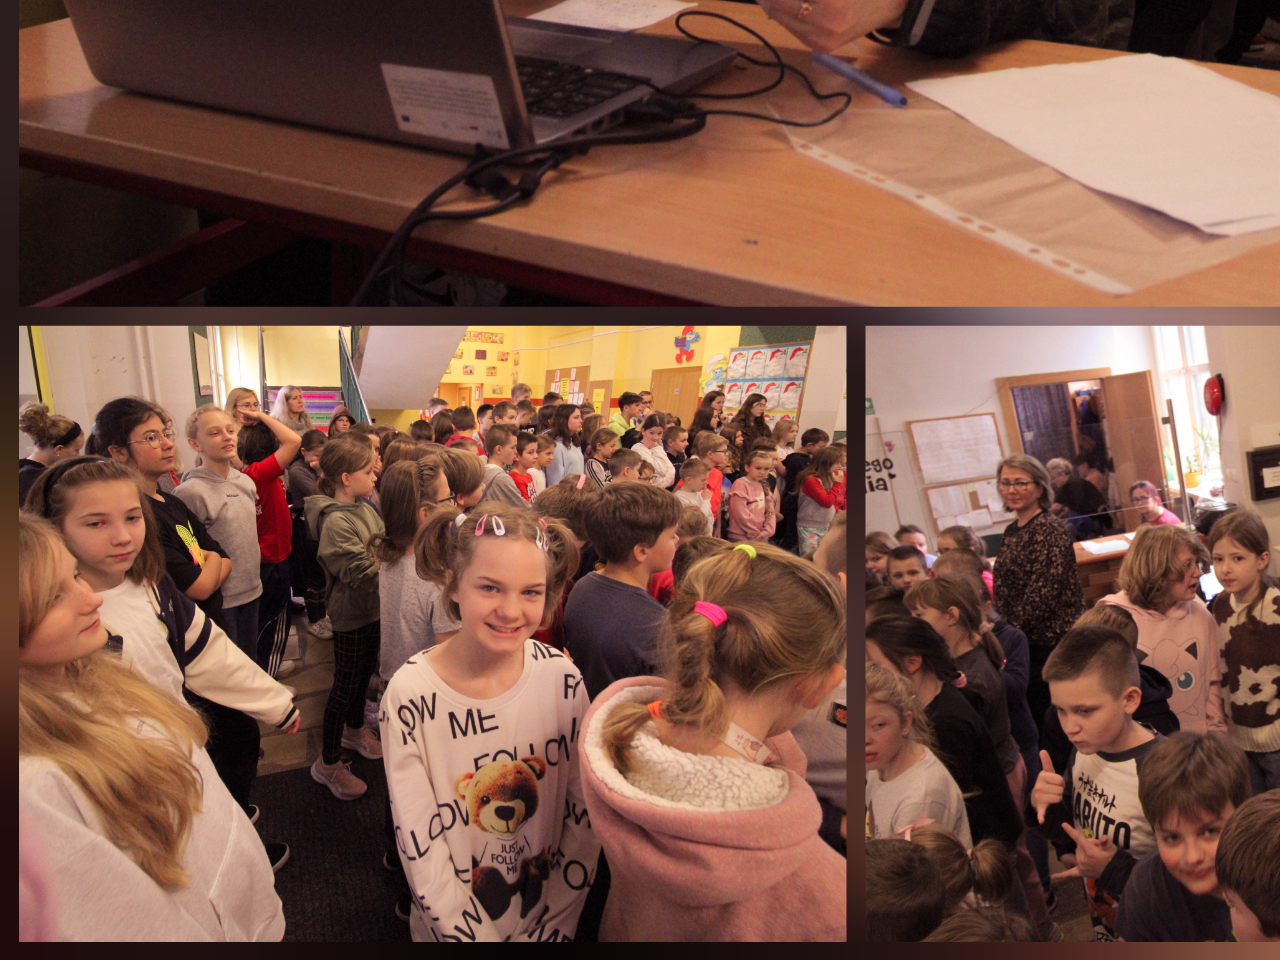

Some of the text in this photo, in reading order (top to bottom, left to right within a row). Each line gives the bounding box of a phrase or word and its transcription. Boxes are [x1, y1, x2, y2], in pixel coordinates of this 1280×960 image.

[866, 457, 893, 473] ego
[448, 708, 500, 740] ME
[1072, 787, 1131, 850] ARUTO
[491, 844, 525, 866] FOLLOW
[500, 841, 520, 854] JUST
[506, 866, 519, 876] ME
